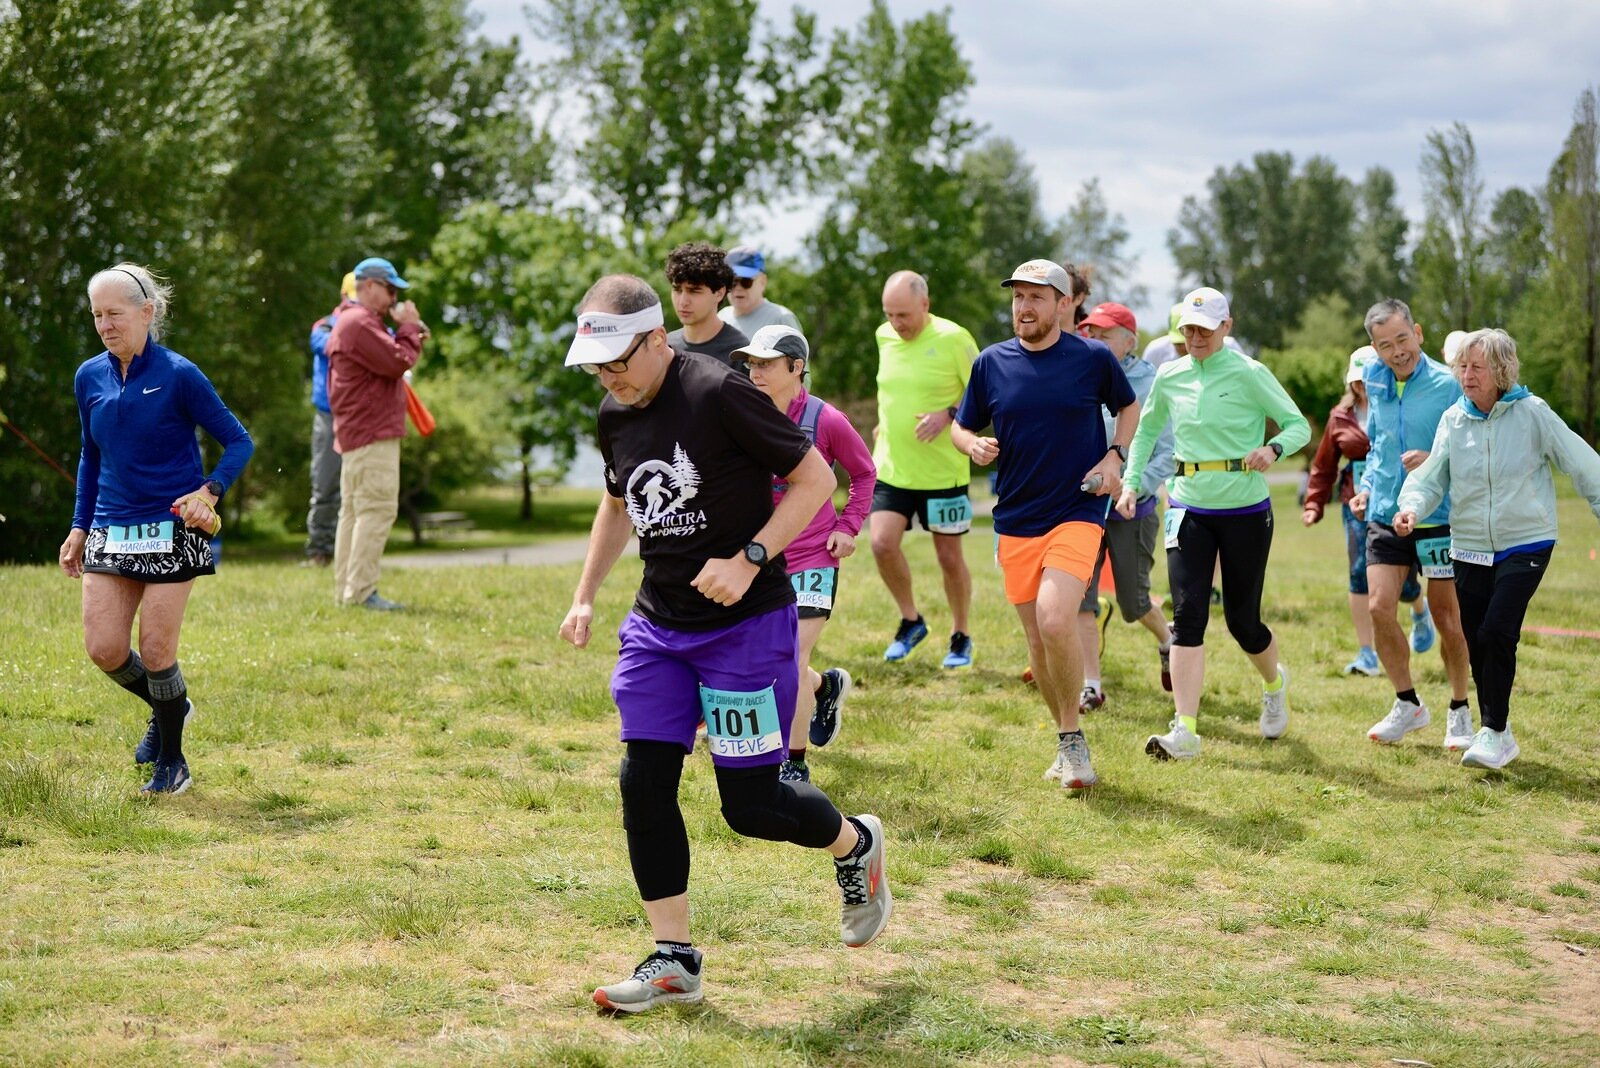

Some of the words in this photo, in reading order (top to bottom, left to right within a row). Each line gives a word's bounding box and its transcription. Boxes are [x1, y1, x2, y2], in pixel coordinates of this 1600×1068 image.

[661, 509, 707, 528] ULTRA
[938, 505, 965, 523] 107
[711, 707, 760, 737] 101
[719, 736, 769, 755] STEVE
